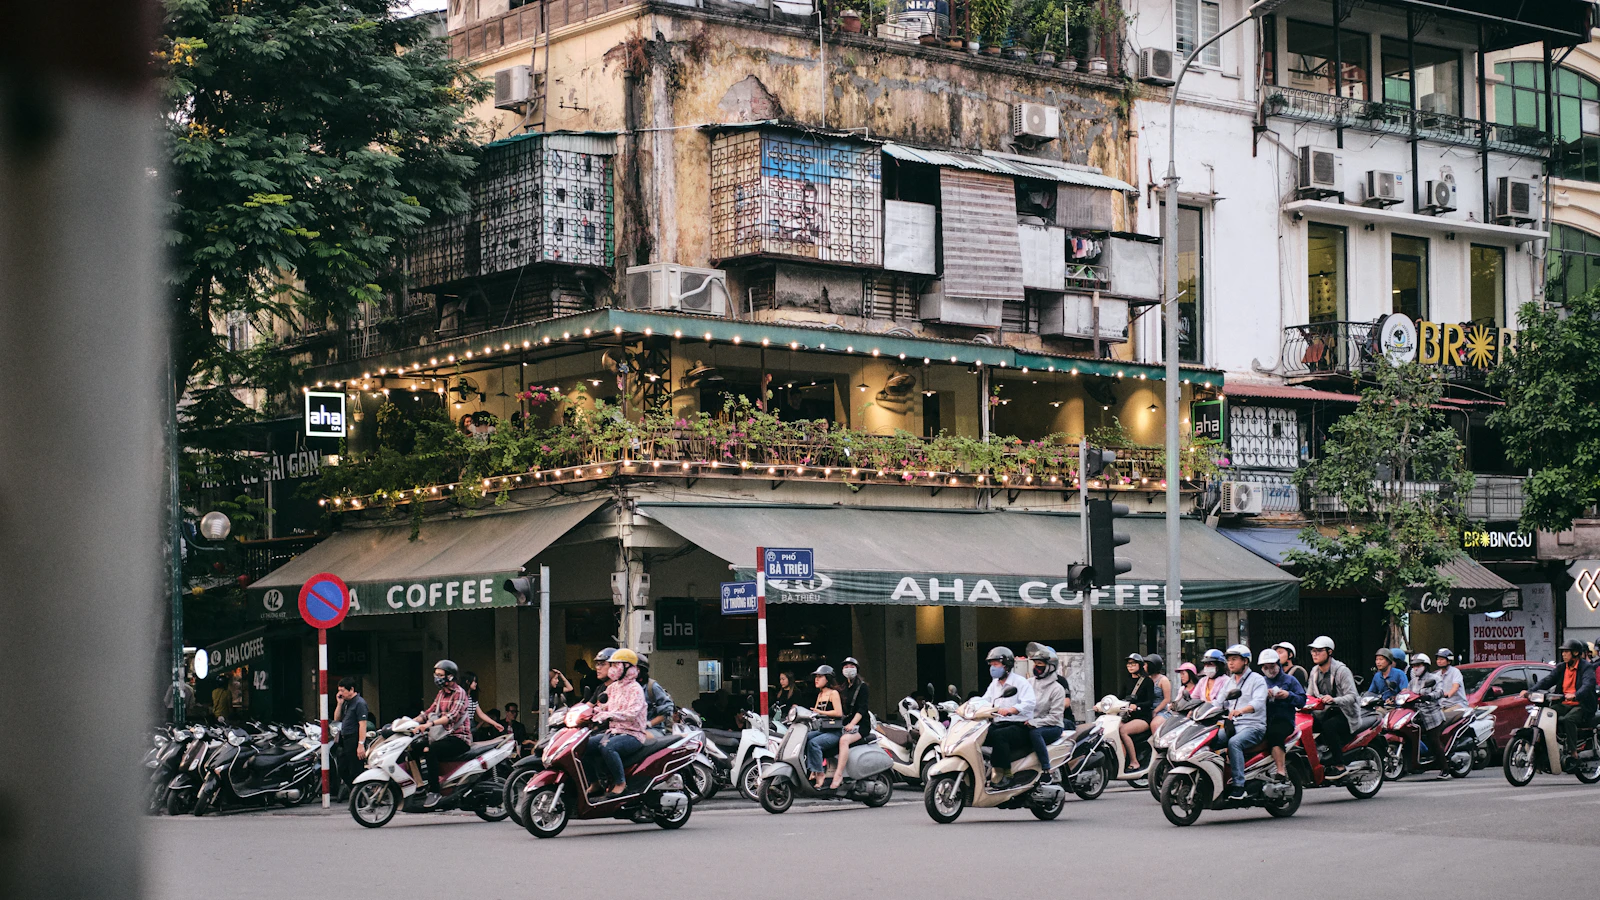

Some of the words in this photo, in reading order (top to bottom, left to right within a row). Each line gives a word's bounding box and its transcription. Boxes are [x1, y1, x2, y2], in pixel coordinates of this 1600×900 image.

[310, 404, 342, 425] aha
[1195, 414, 1220, 433] aha
[288, 446, 320, 478] GÒN
[781, 552, 797, 561] PHỐ
[769, 561, 782, 575] BÀ
[784, 562, 809, 576] TRIỆU
[386, 578, 494, 609] COFFEE
[733, 585, 746, 594] PHỐ
[781, 592, 793, 602] BÀ
[890, 576, 1002, 603] AHA
[267, 591, 279, 608] 42
[1459, 596, 1477, 609] 40
[663, 615, 694, 636] aha
[1473, 626, 1525, 638] PHOTOCOPY
[225, 645, 240, 667] AHA
[240, 637, 264, 661] COFFEE
[1483, 642, 1497, 651] Sang
[676, 658, 685, 666] 40
[253, 670, 267, 690] 42
